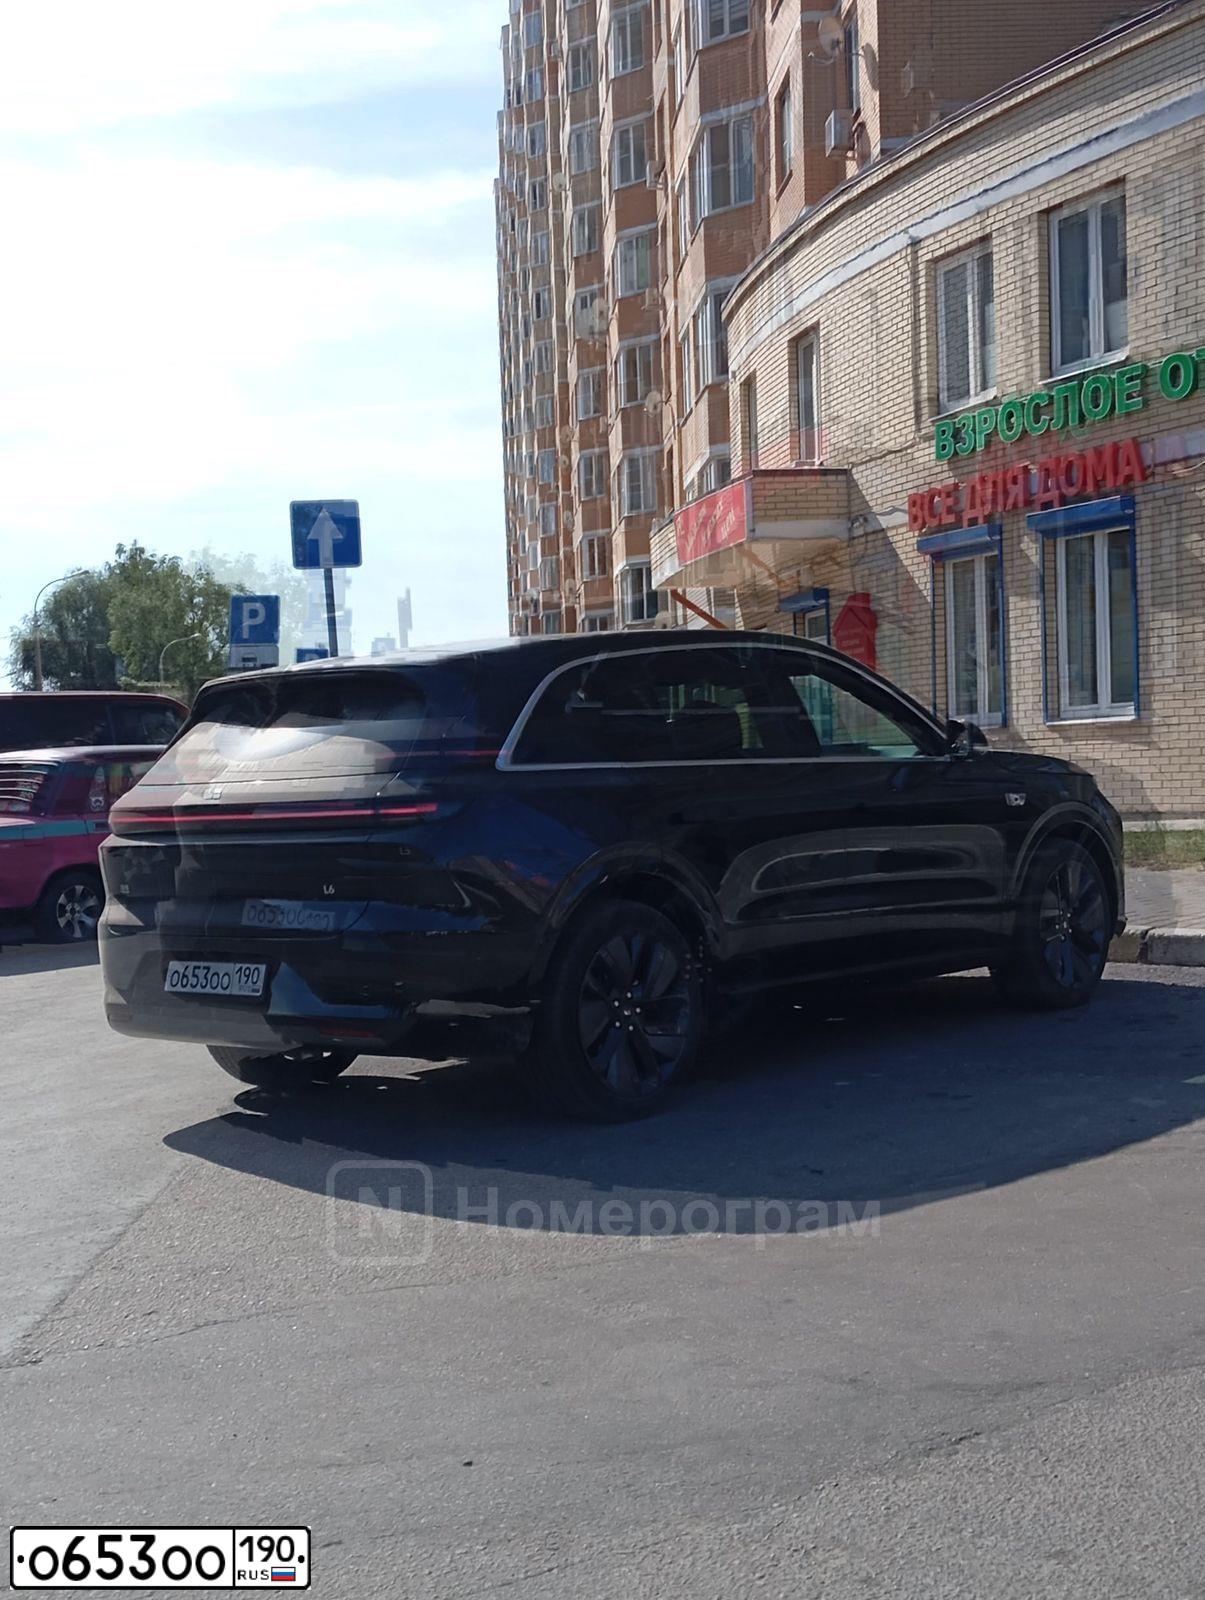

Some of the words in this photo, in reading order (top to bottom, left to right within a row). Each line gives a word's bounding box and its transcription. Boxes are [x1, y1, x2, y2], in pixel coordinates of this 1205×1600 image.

[934, 362, 1147, 461] ВЗРОСЛОЕ
[1159, 347, 1205, 401] О
[907, 481, 959, 532] ВСЕ
[962, 461, 1030, 528] ДЛЯ
[1036, 437, 1147, 510] ДОМА
[241, 601, 266, 640] P
[235, 964, 260, 985] 190
